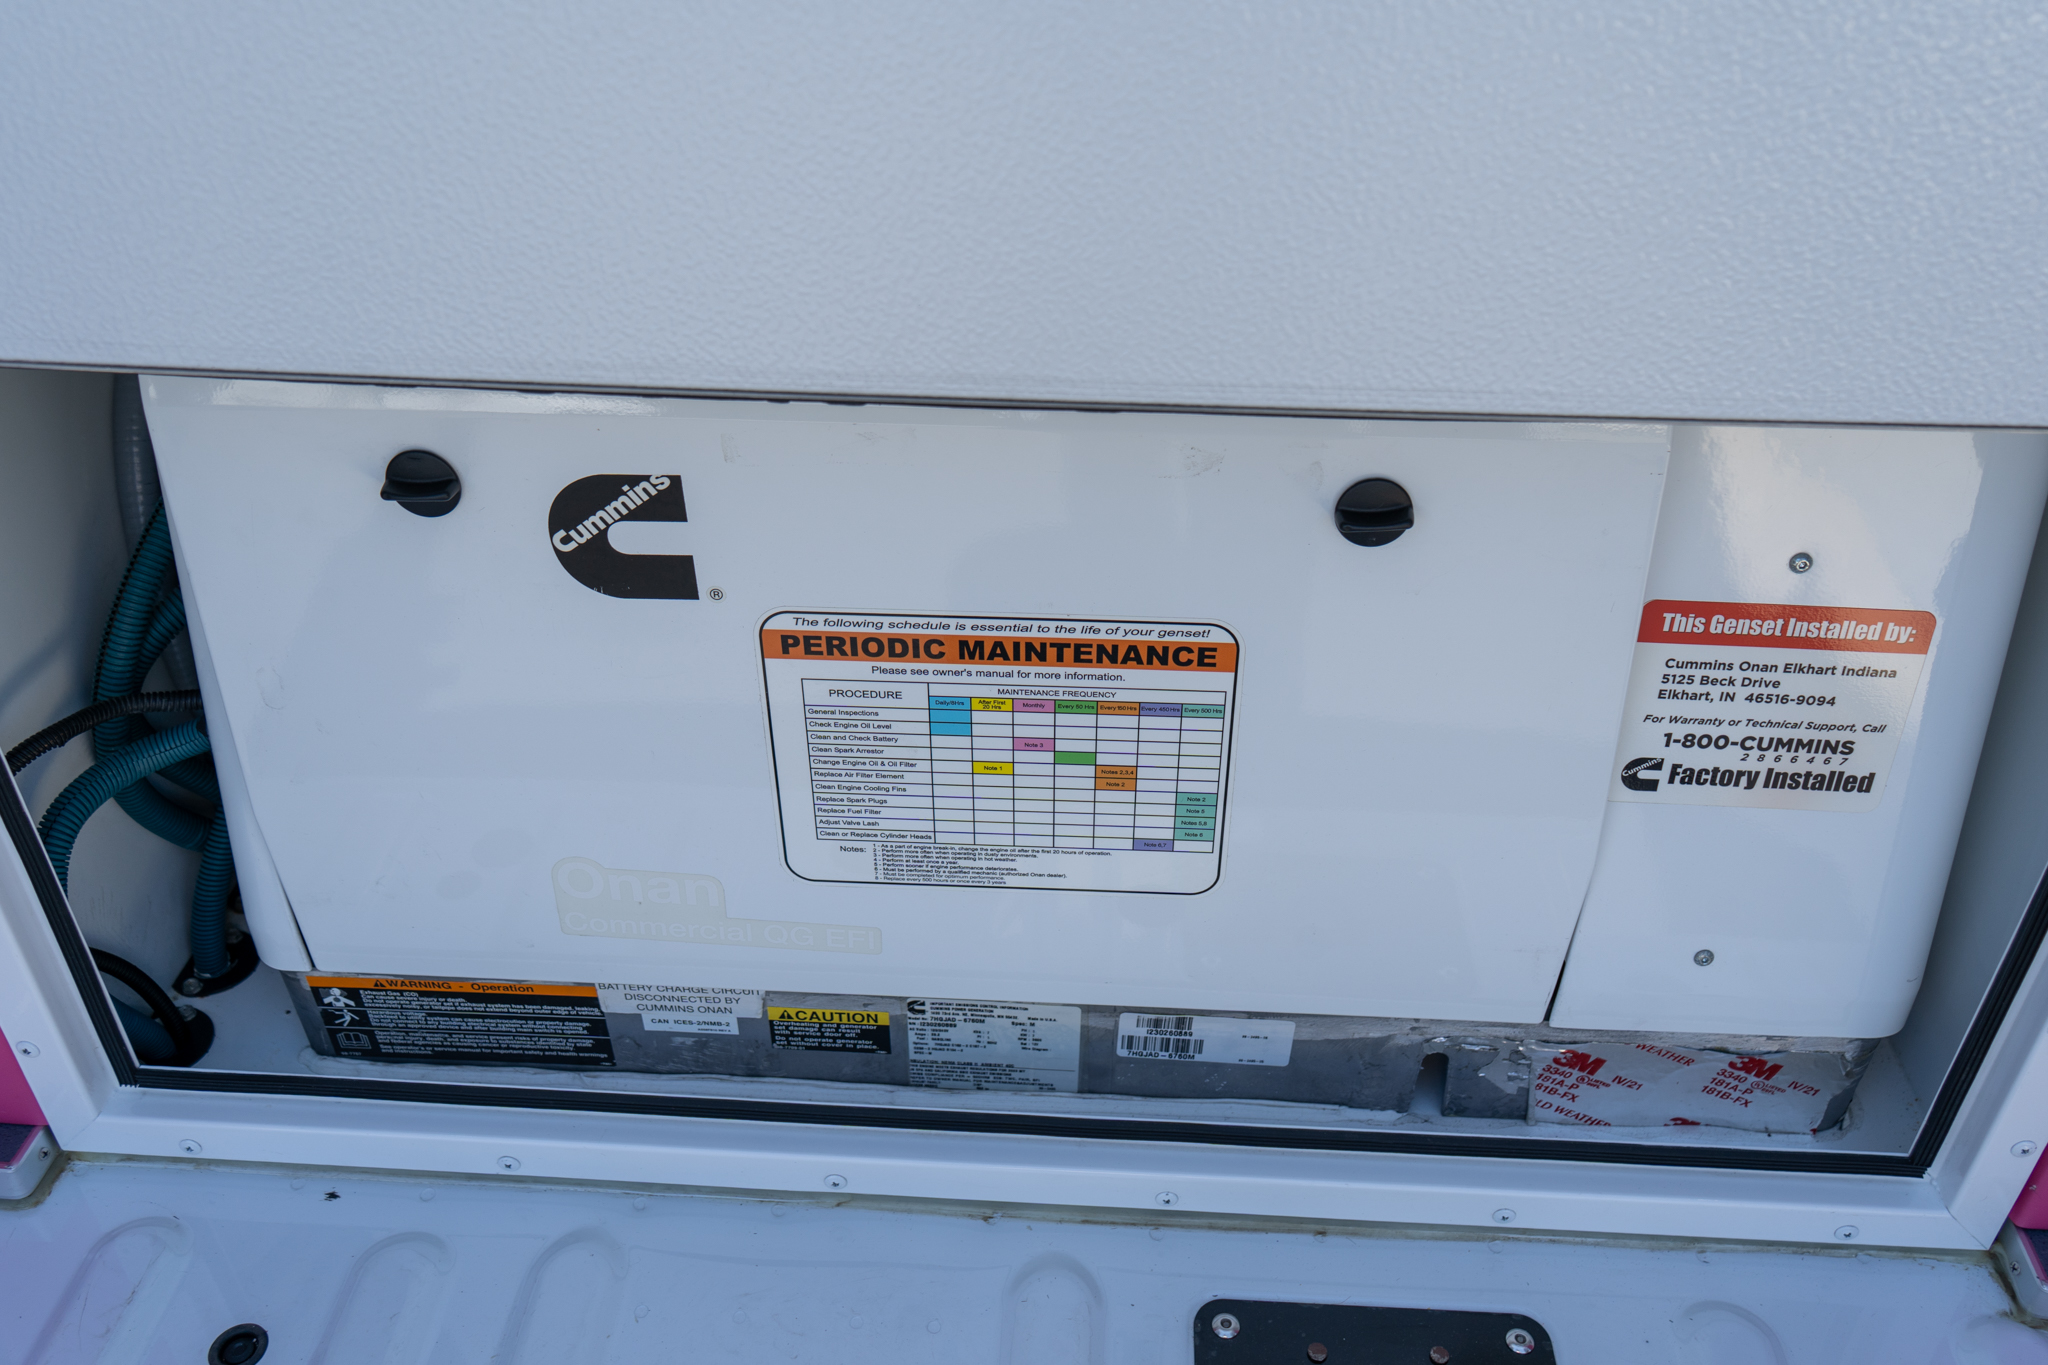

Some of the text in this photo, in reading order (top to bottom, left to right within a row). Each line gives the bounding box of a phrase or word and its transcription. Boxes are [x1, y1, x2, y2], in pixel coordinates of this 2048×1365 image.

[552, 474, 671, 552] Cummins
[794, 618, 1210, 638] The following schedule is essential to the life of your genset!
[1663, 613, 1917, 644] This Genset Installed by:
[780, 635, 1217, 667] PERIODIC MAINTENANCE
[871, 666, 907, 675] Please
[933, 669, 972, 677] owner's
[976, 669, 1013, 678] manual
[1017, 670, 1031, 678] for
[1064, 672, 1126, 681] information.
[1665, 658, 1897, 678] Cummins Onan Elkhart Indiana
[1661, 675, 1780, 688] 5125 Beck Drive
[829, 689, 902, 699] PROCEDURE
[1658, 689, 1836, 706] Elkhart, IN 46516-9094
[1643, 715, 1665, 723] For
[1668, 716, 1725, 727] Warranty
[1745, 719, 1803, 730] Technical
[1805, 721, 1857, 733] Support,
[1862, 724, 1887, 733] Call
[1663, 732, 1855, 755] 1-800-CUMMINS
[1622, 758, 1662, 777] Cummins
[1757, 754, 1766, 762] 8
[1773, 755, 1782, 763] 6
[1790, 755, 1799, 764] 6
[1806, 756, 1815, 764] 4
[1823, 757, 1831, 765] 6
[1839, 758, 1849, 766] 7
[1668, 764, 1876, 793] Factory Installed
[557, 861, 720, 907] Onan
[565, 912, 874, 949] Commercial QG EFI
[386, 980, 452, 989] WARNING
[471, 983, 534, 992] Operation
[599, 983, 652, 991] BATTERY
[656, 986, 708, 994] CHARGE
[624, 993, 721, 1003] DISCONNECTED
[637, 1004, 732, 1014] CUMMINS ONAN
[795, 1011, 878, 1023] CAUTION
[1553, 1049, 1607, 1076] 3M
[1636, 1044, 1695, 1066] WEATHER
[1543, 1064, 1573, 1078] 3340
[1717, 1069, 1747, 1083] 3340
[1728, 1056, 1784, 1081] 3M
[1537, 1073, 1579, 1090] 181A-P
[1611, 1076, 1643, 1091] IV/21
[1710, 1078, 1753, 1095] 181A-P
[1788, 1081, 1821, 1096] IV/21
[1535, 1083, 1579, 1102] 81B-FX
[1701, 1085, 1753, 1108] 181B-FX
